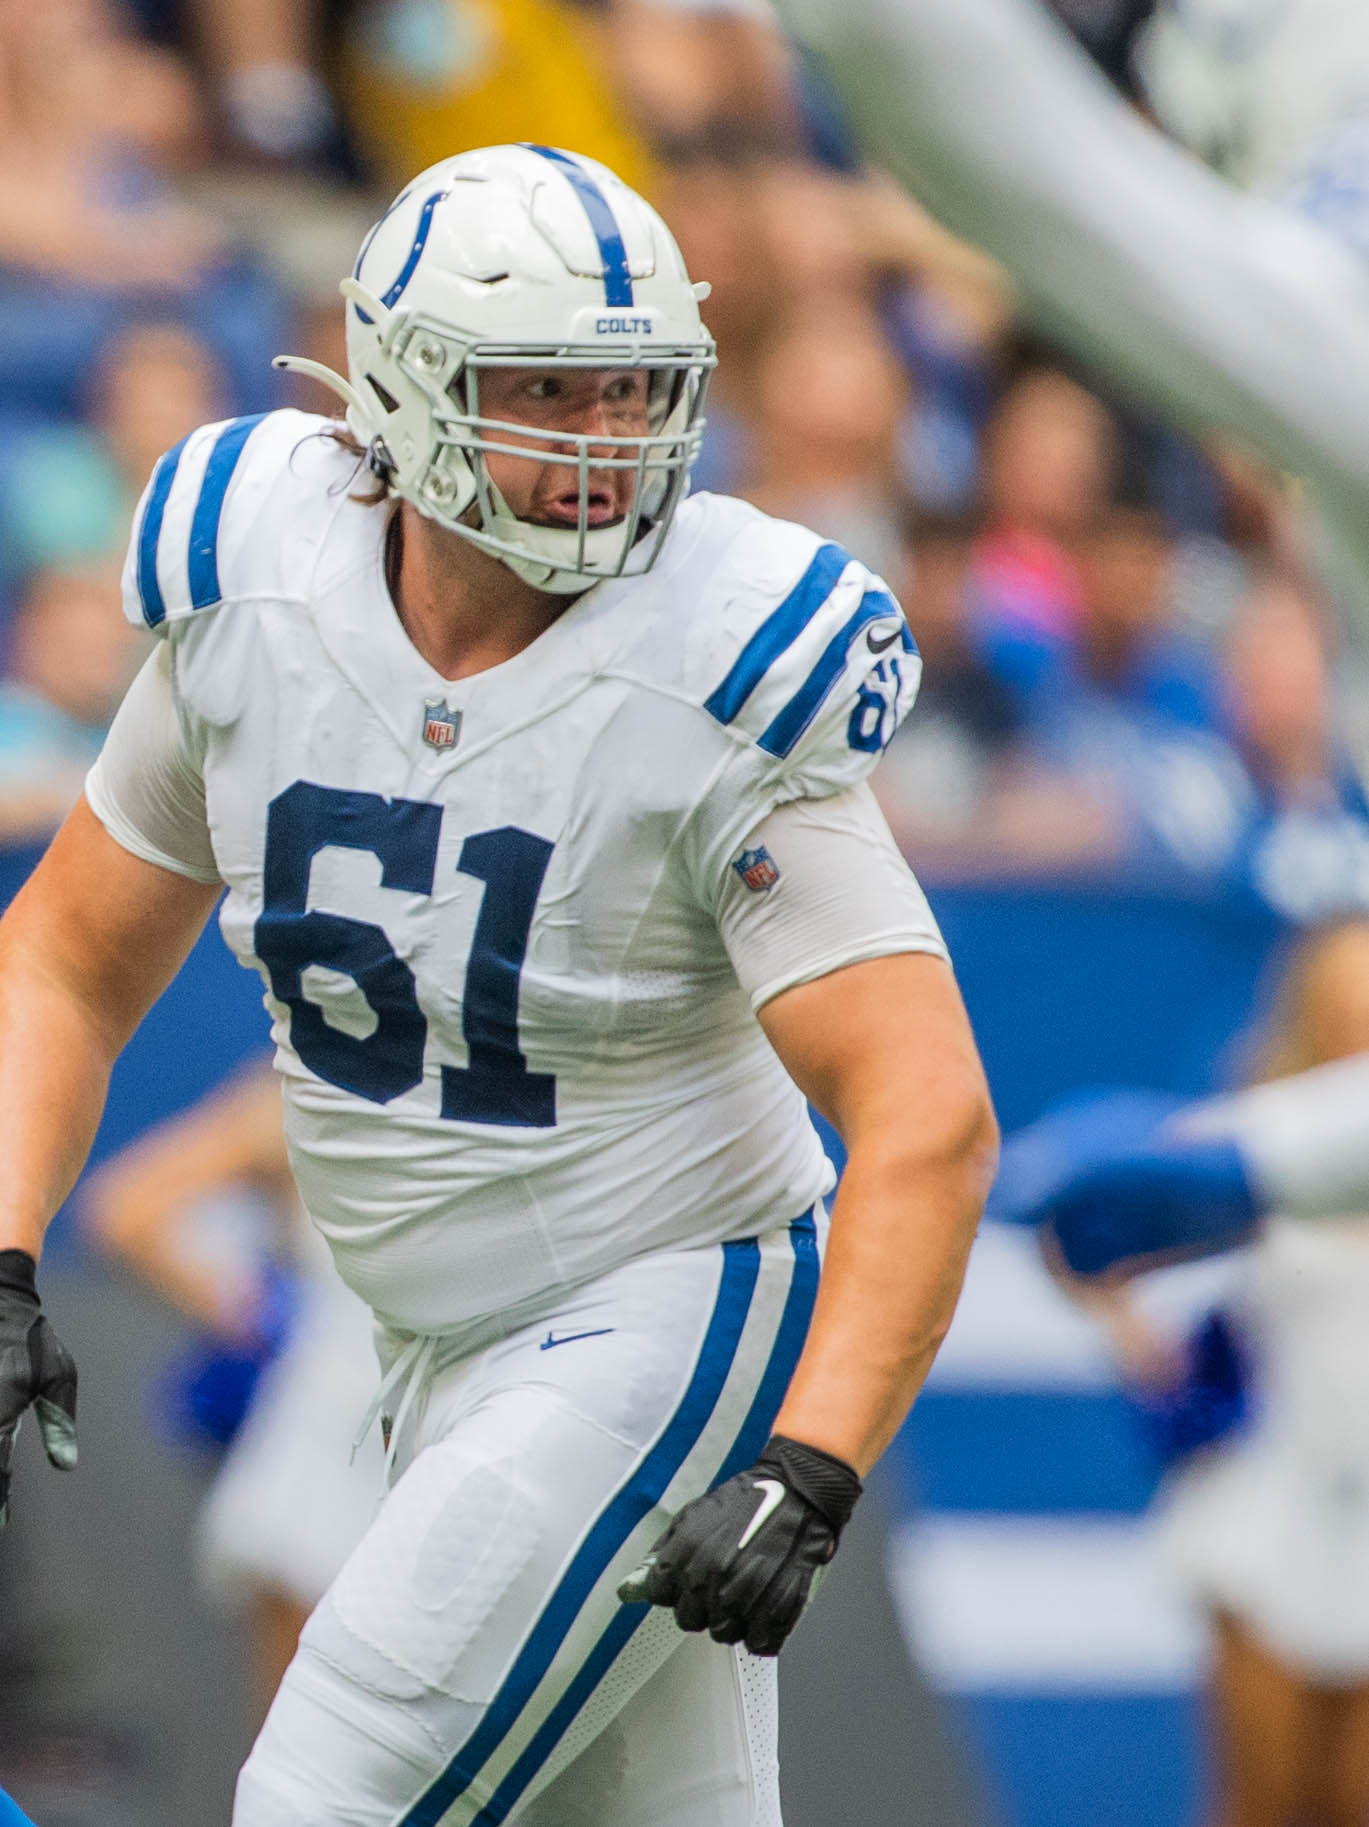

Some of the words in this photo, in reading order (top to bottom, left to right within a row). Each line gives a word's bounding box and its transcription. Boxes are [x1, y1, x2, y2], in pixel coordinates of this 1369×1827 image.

[596, 318, 652, 334] COLTS
[427, 723, 453, 744] NFL
[746, 861, 776, 888] NFL
[254, 779, 557, 1127] 61
